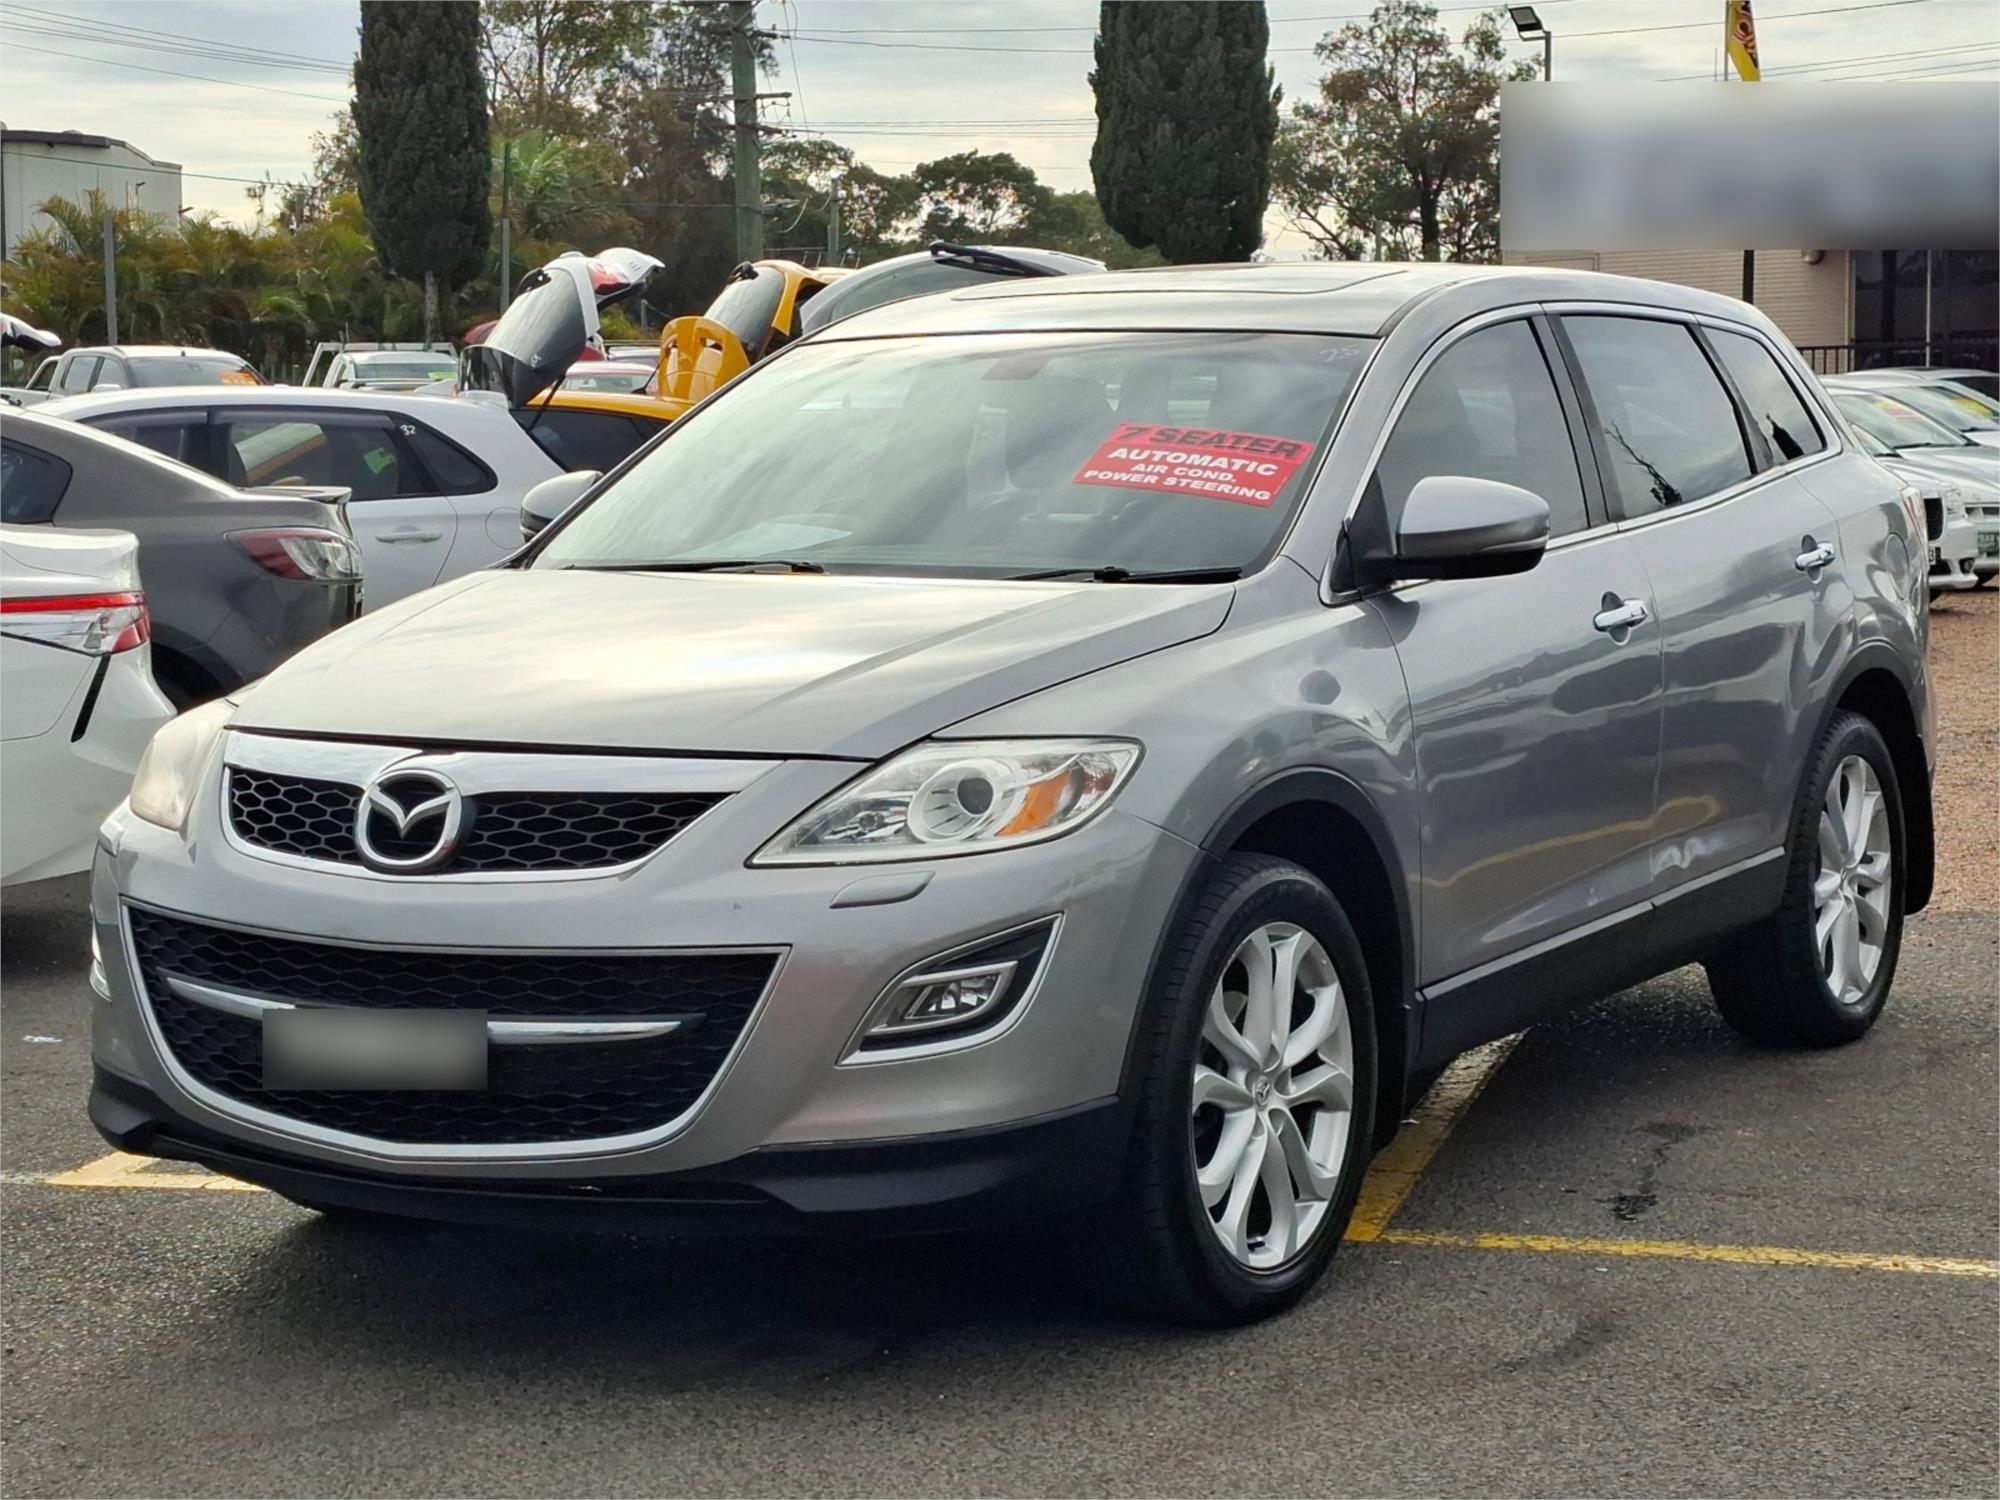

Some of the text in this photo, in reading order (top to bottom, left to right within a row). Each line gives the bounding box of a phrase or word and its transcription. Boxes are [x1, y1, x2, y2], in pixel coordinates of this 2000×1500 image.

[1117, 427, 1302, 459] 7 SEATER
[1108, 448, 1278, 476] AUTOMATIC
[1131, 463, 1236, 482] AIR COND.
[1084, 470, 1271, 501] POWER STEERING
